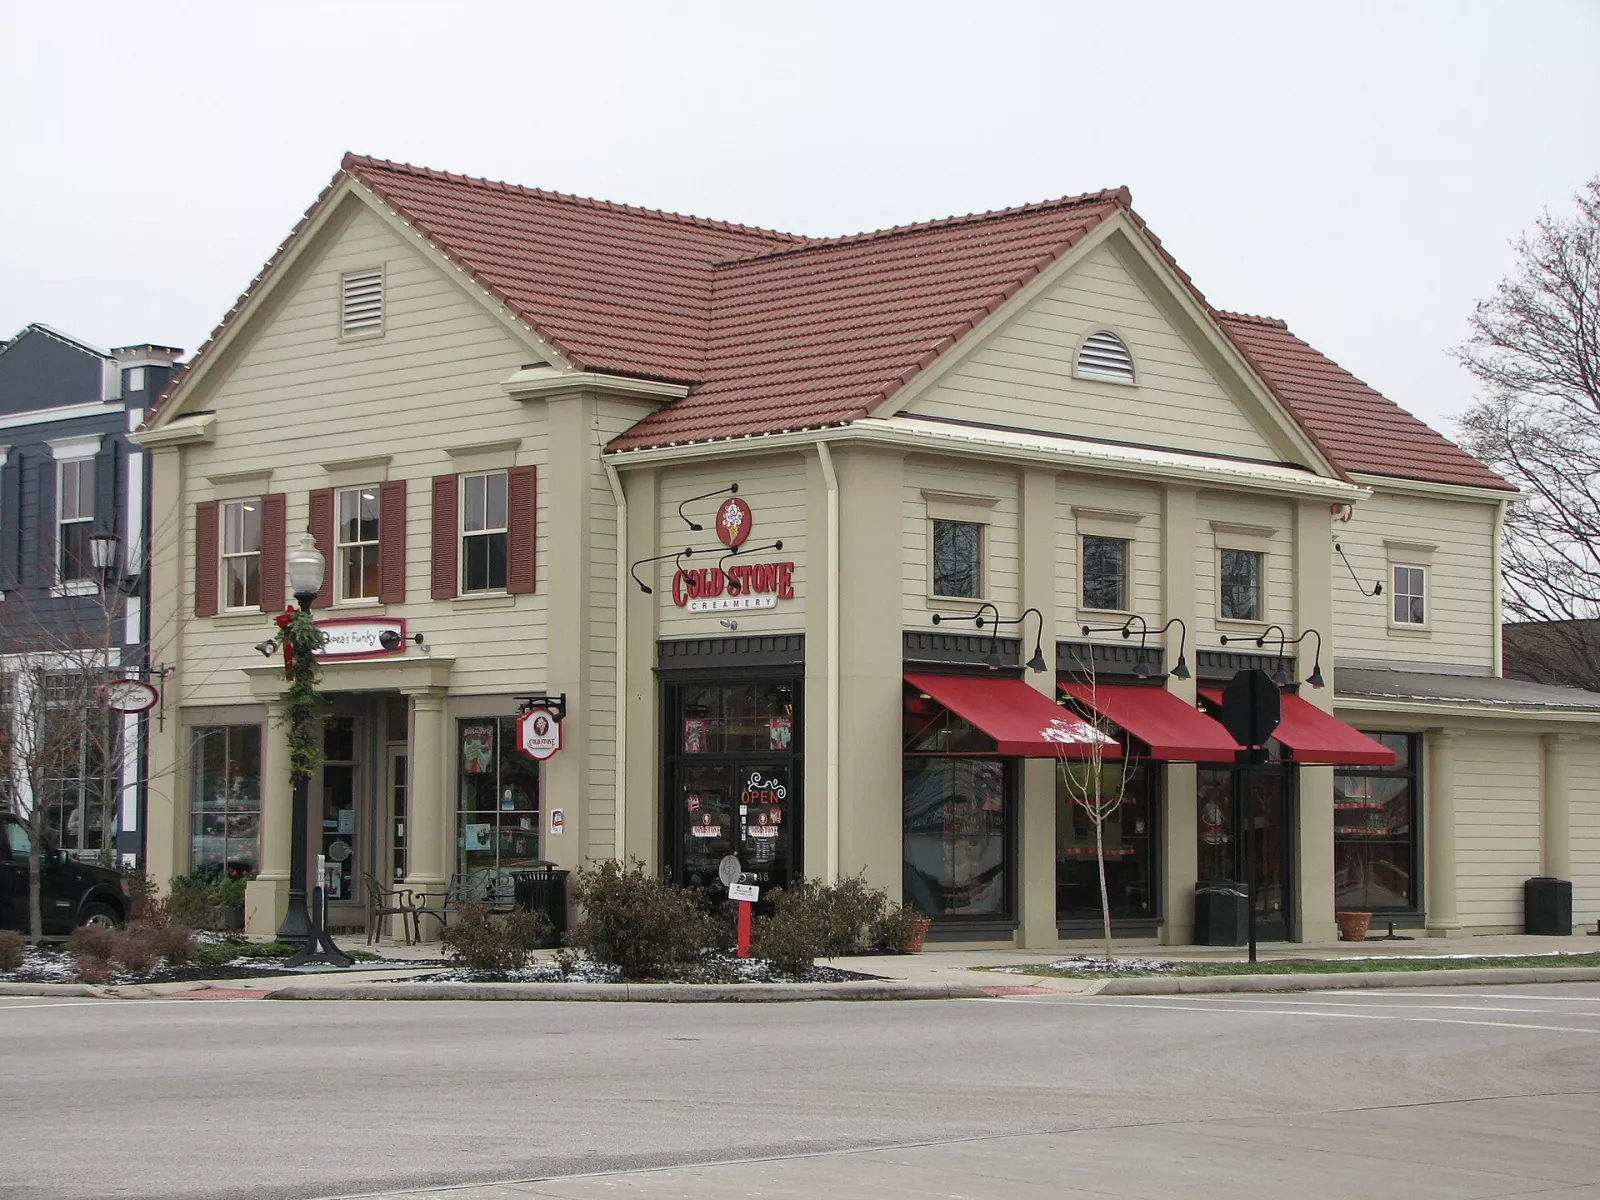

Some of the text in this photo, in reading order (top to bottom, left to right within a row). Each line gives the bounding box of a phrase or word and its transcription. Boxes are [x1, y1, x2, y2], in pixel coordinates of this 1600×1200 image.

[672, 562, 794, 607] COLD STONE
[691, 598, 771, 610] CREAMERY
[352, 630, 376, 647] Funky
[741, 790, 778, 804] OPEN
